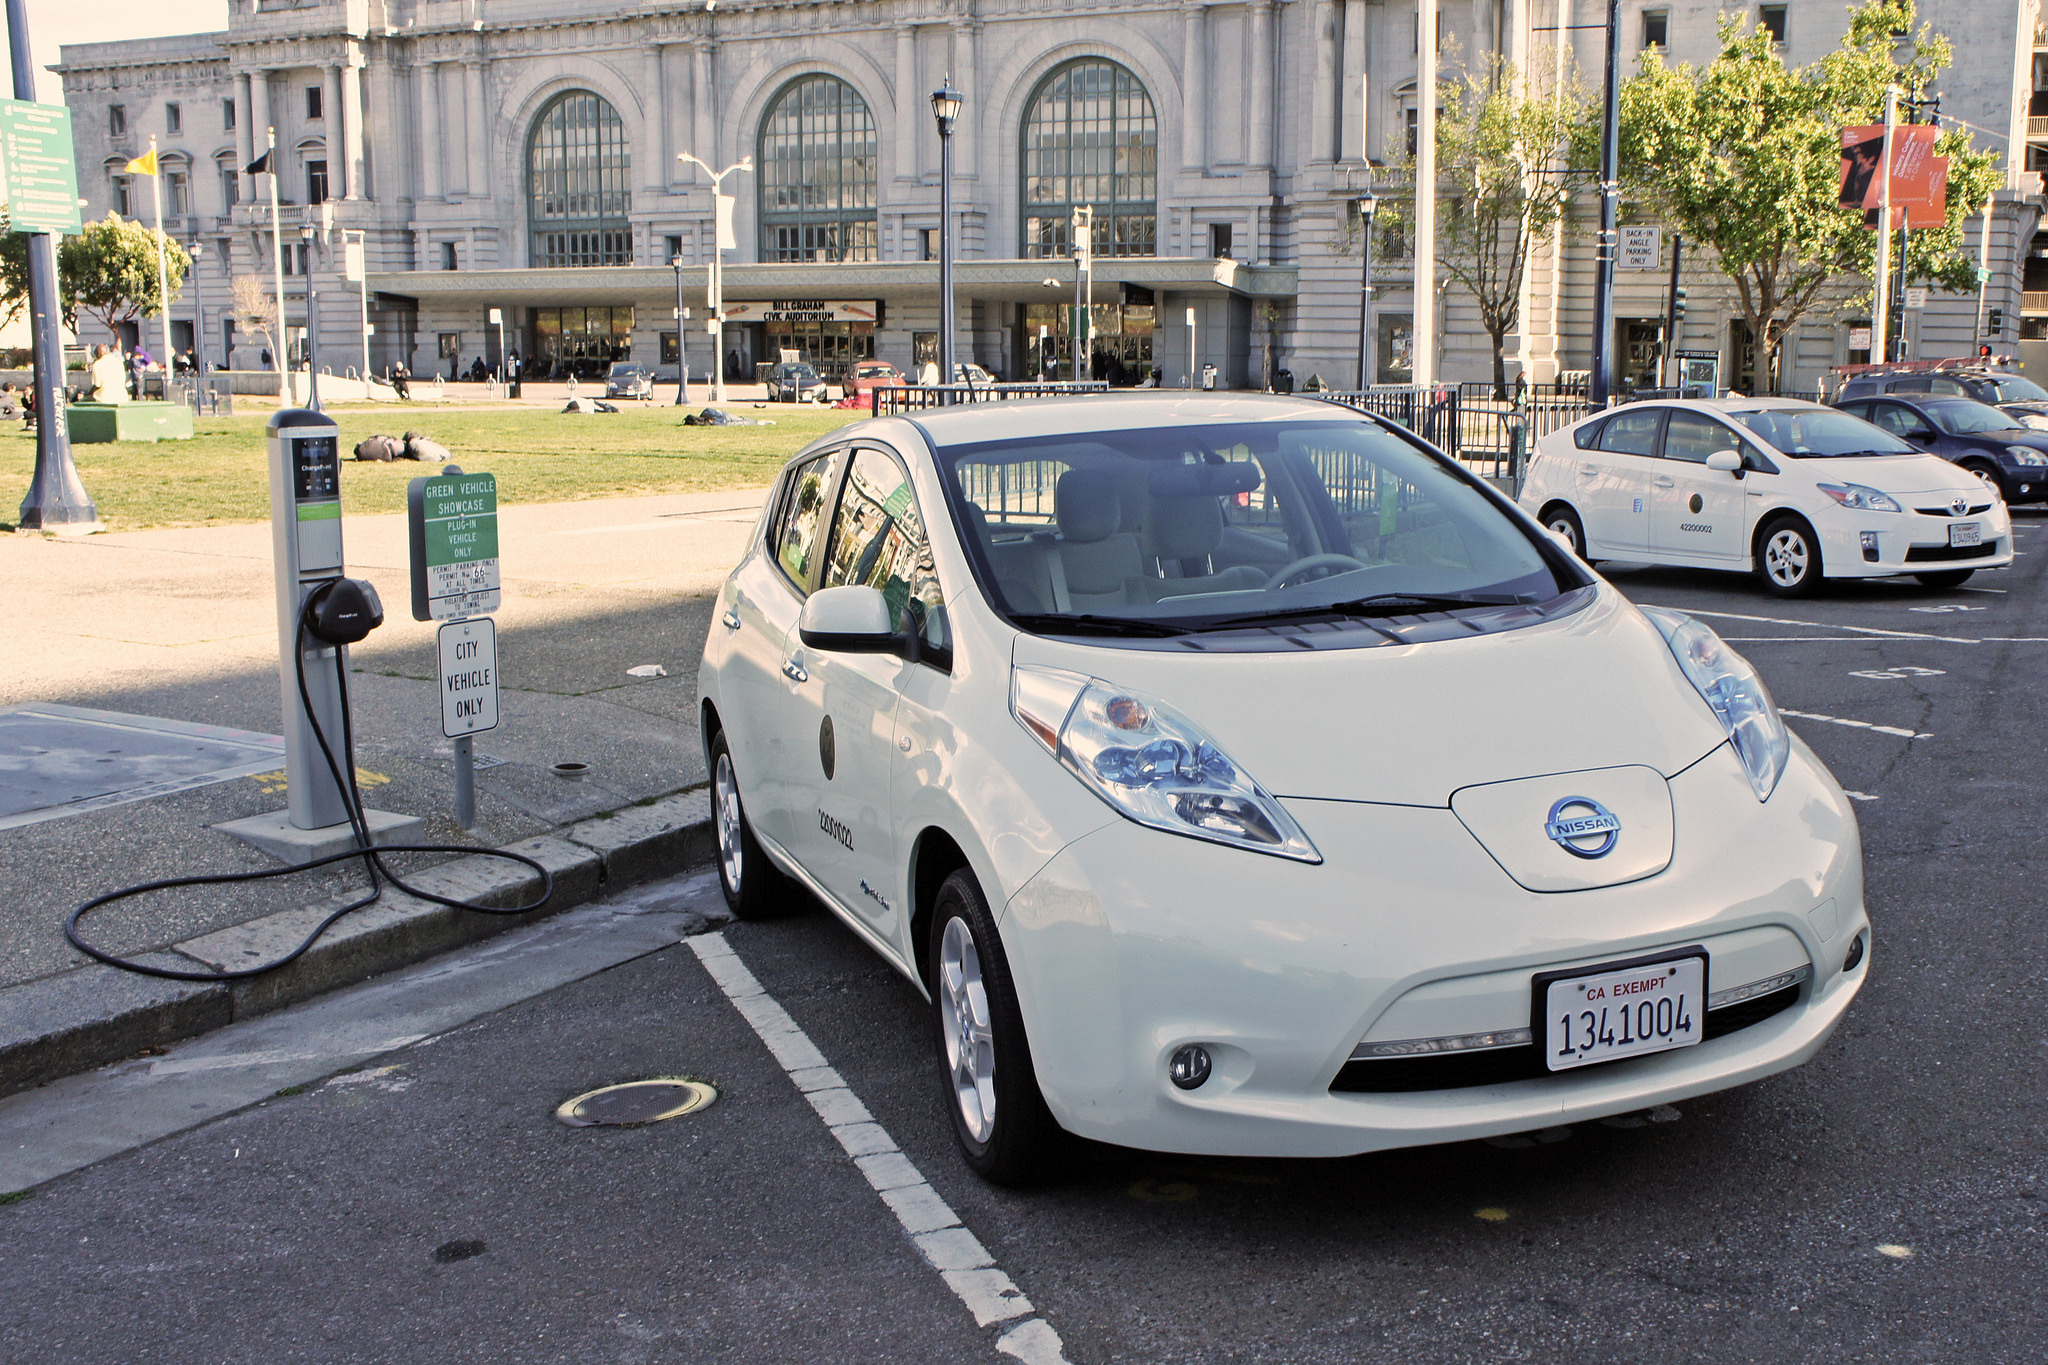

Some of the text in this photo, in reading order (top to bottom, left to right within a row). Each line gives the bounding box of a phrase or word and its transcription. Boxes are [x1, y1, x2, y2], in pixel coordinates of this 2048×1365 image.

[1626, 229, 1653, 237] BACK-IN
[772, 301, 825, 311] BILL GRAHAM
[763, 312, 834, 321] CIVIC AUDITORIUM
[426, 480, 495, 498] GREEN VEHICLE
[438, 499, 484, 515] SHOWCASE
[447, 519, 477, 531] PLUG-IN
[1680, 523, 1713, 533] 42200002
[448, 532, 477, 545] VEHICLE
[454, 546, 472, 558] ONLY
[433, 565, 452, 574] PERMIT
[456, 562, 478, 570] PARKING
[439, 572, 458, 580] PERMIT
[474, 567, 485, 577] 66
[456, 579, 466, 587] ALL
[470, 577, 486, 585] TIMES
[456, 640, 478, 660] CITY
[447, 668, 491, 692] VEHICLE
[456, 697, 483, 718] ONLY
[1556, 817, 1614, 834] NISSAN
[1587, 976, 1667, 1001] CA EXEMPT
[1558, 993, 1691, 1056] 1341004
